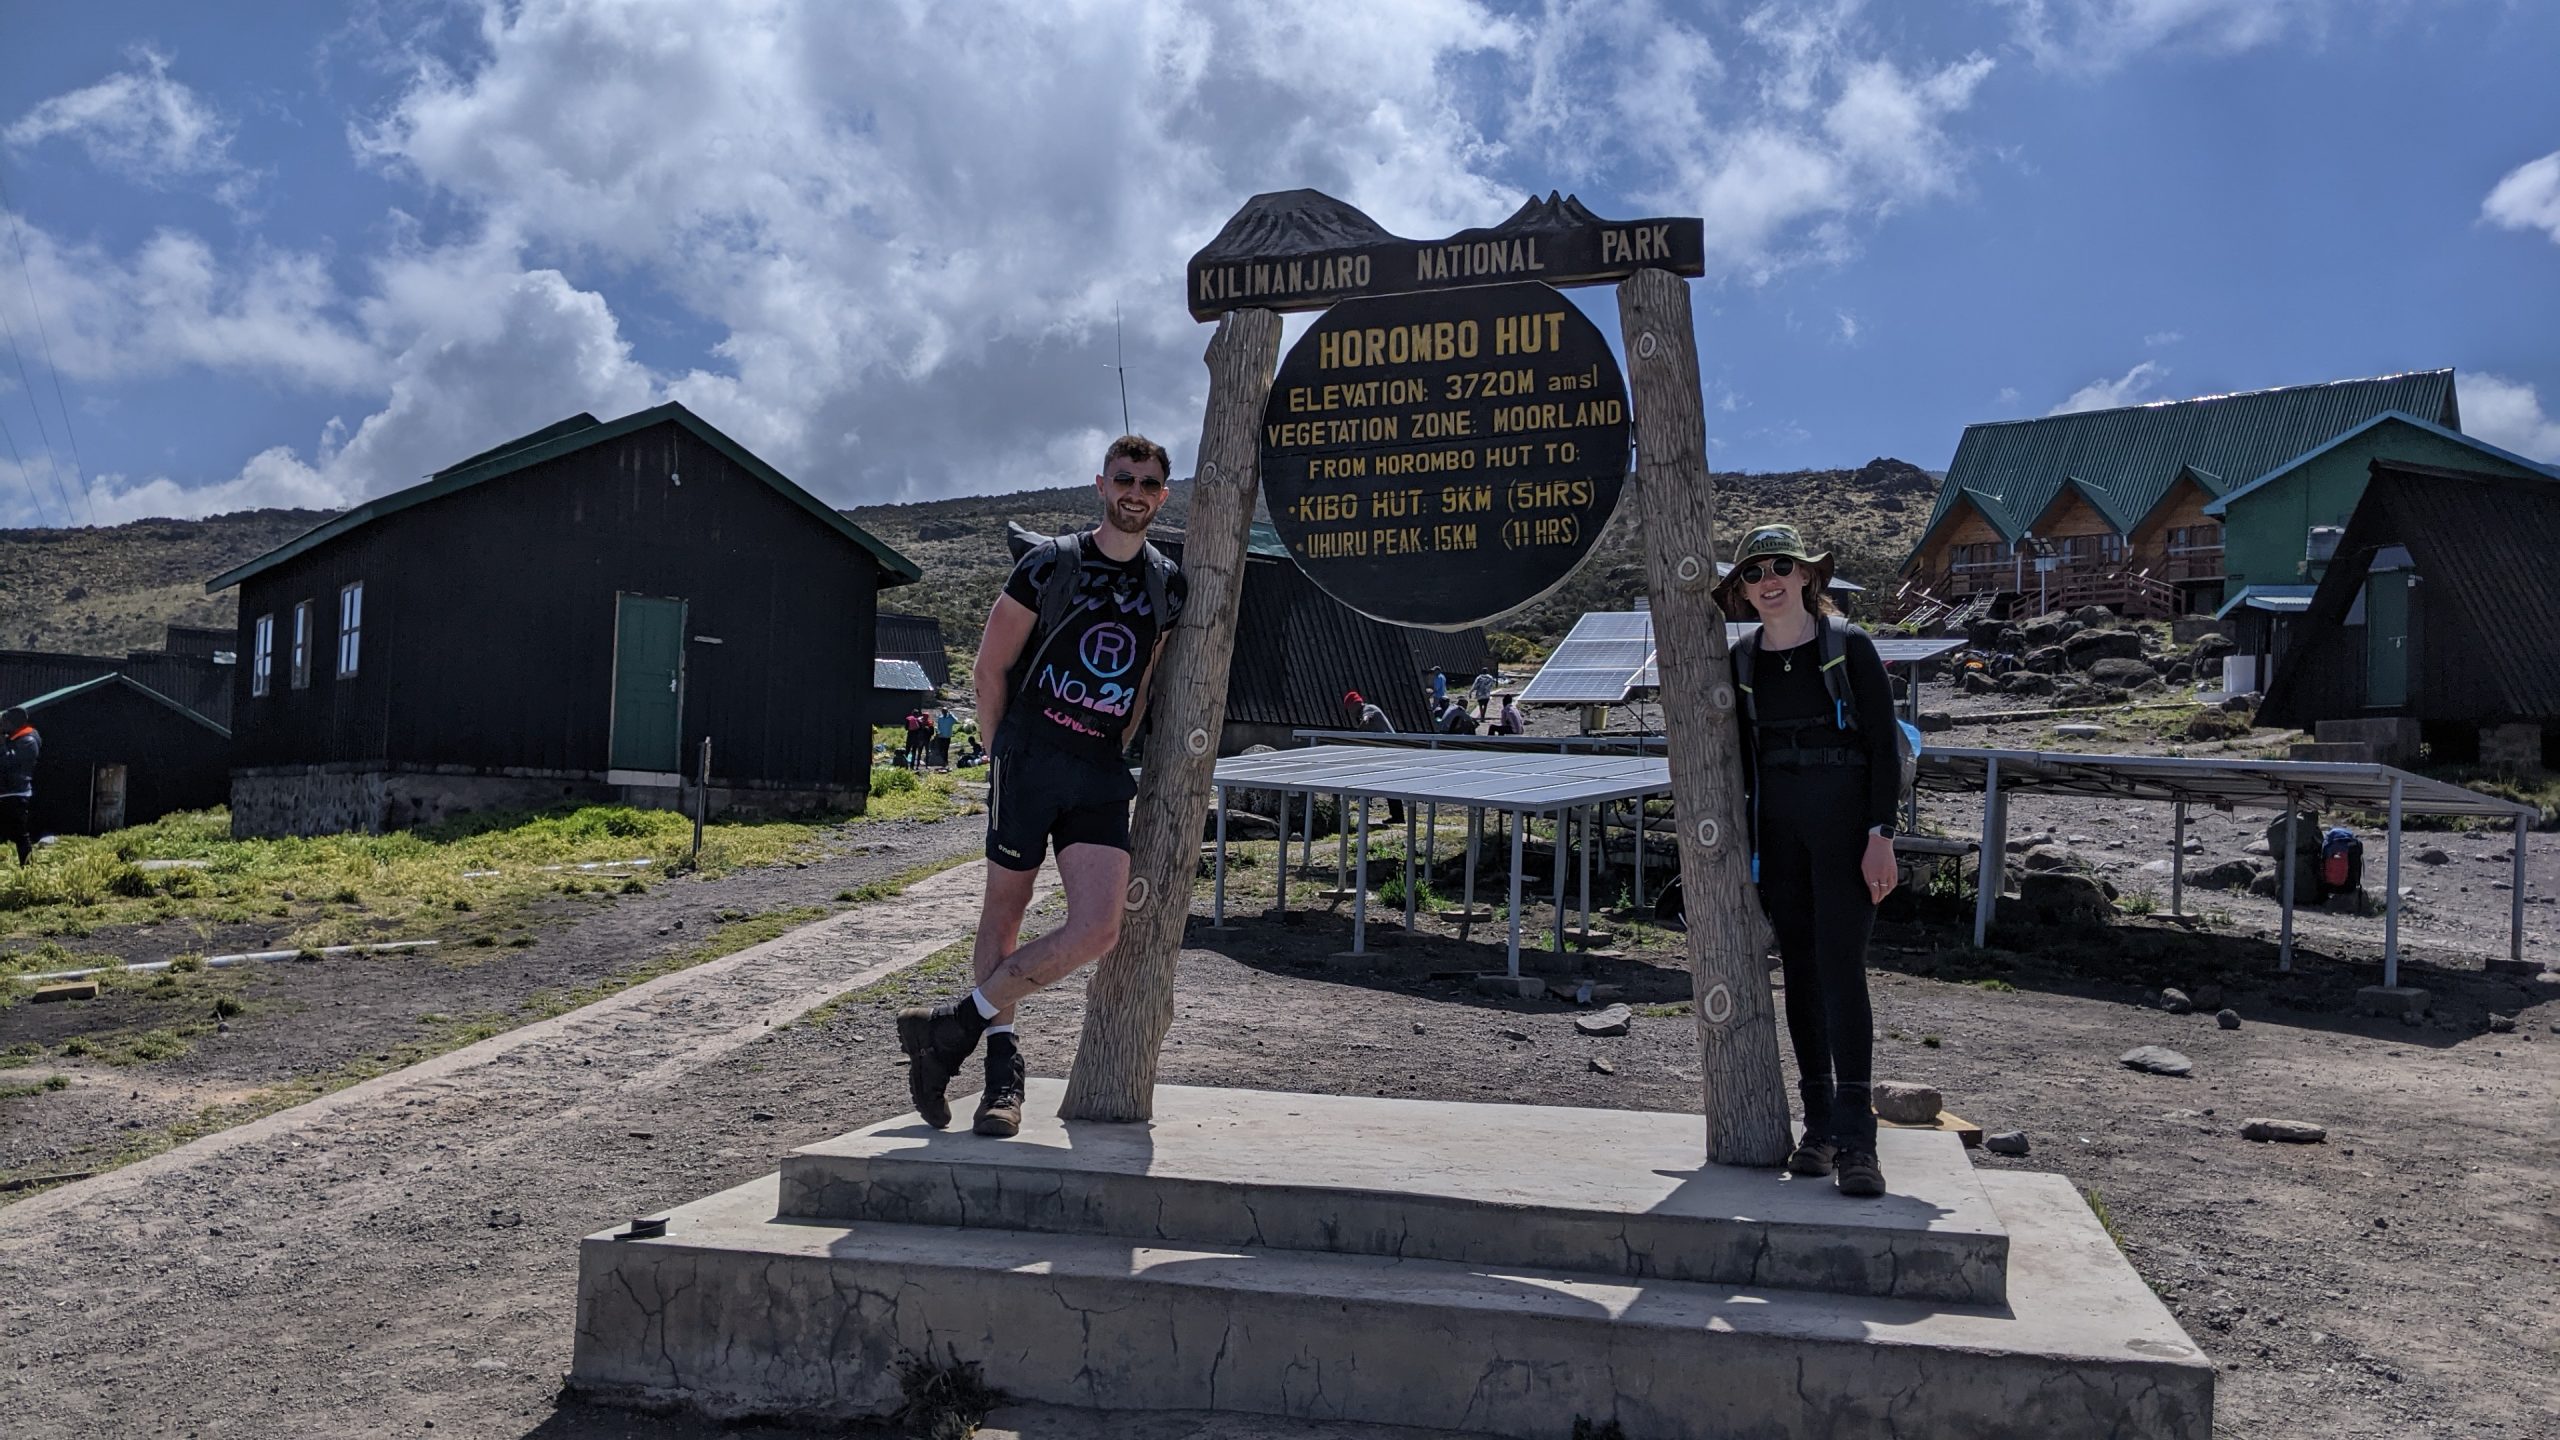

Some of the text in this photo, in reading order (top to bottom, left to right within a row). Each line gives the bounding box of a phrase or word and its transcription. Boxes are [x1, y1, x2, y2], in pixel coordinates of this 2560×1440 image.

[1200, 224, 1671, 300] KILIMANJARO NATIONAL PARK
[1319, 312, 1565, 369] HOROMBO HUT
[1289, 363, 1598, 413] ELEVATION: 3720M amsl
[1268, 400, 1622, 448] VEGETATION ZONE: MOORLAND
[1309, 442, 1580, 480] FROM HOROMBO HUT TO:
[1300, 476, 1595, 522] KIBO HUT: 9KM (5HRS)
[1308, 531, 1367, 558] UHURU
[1373, 527, 1429, 555] PEAK:
[1434, 523, 1477, 551] 15KM
